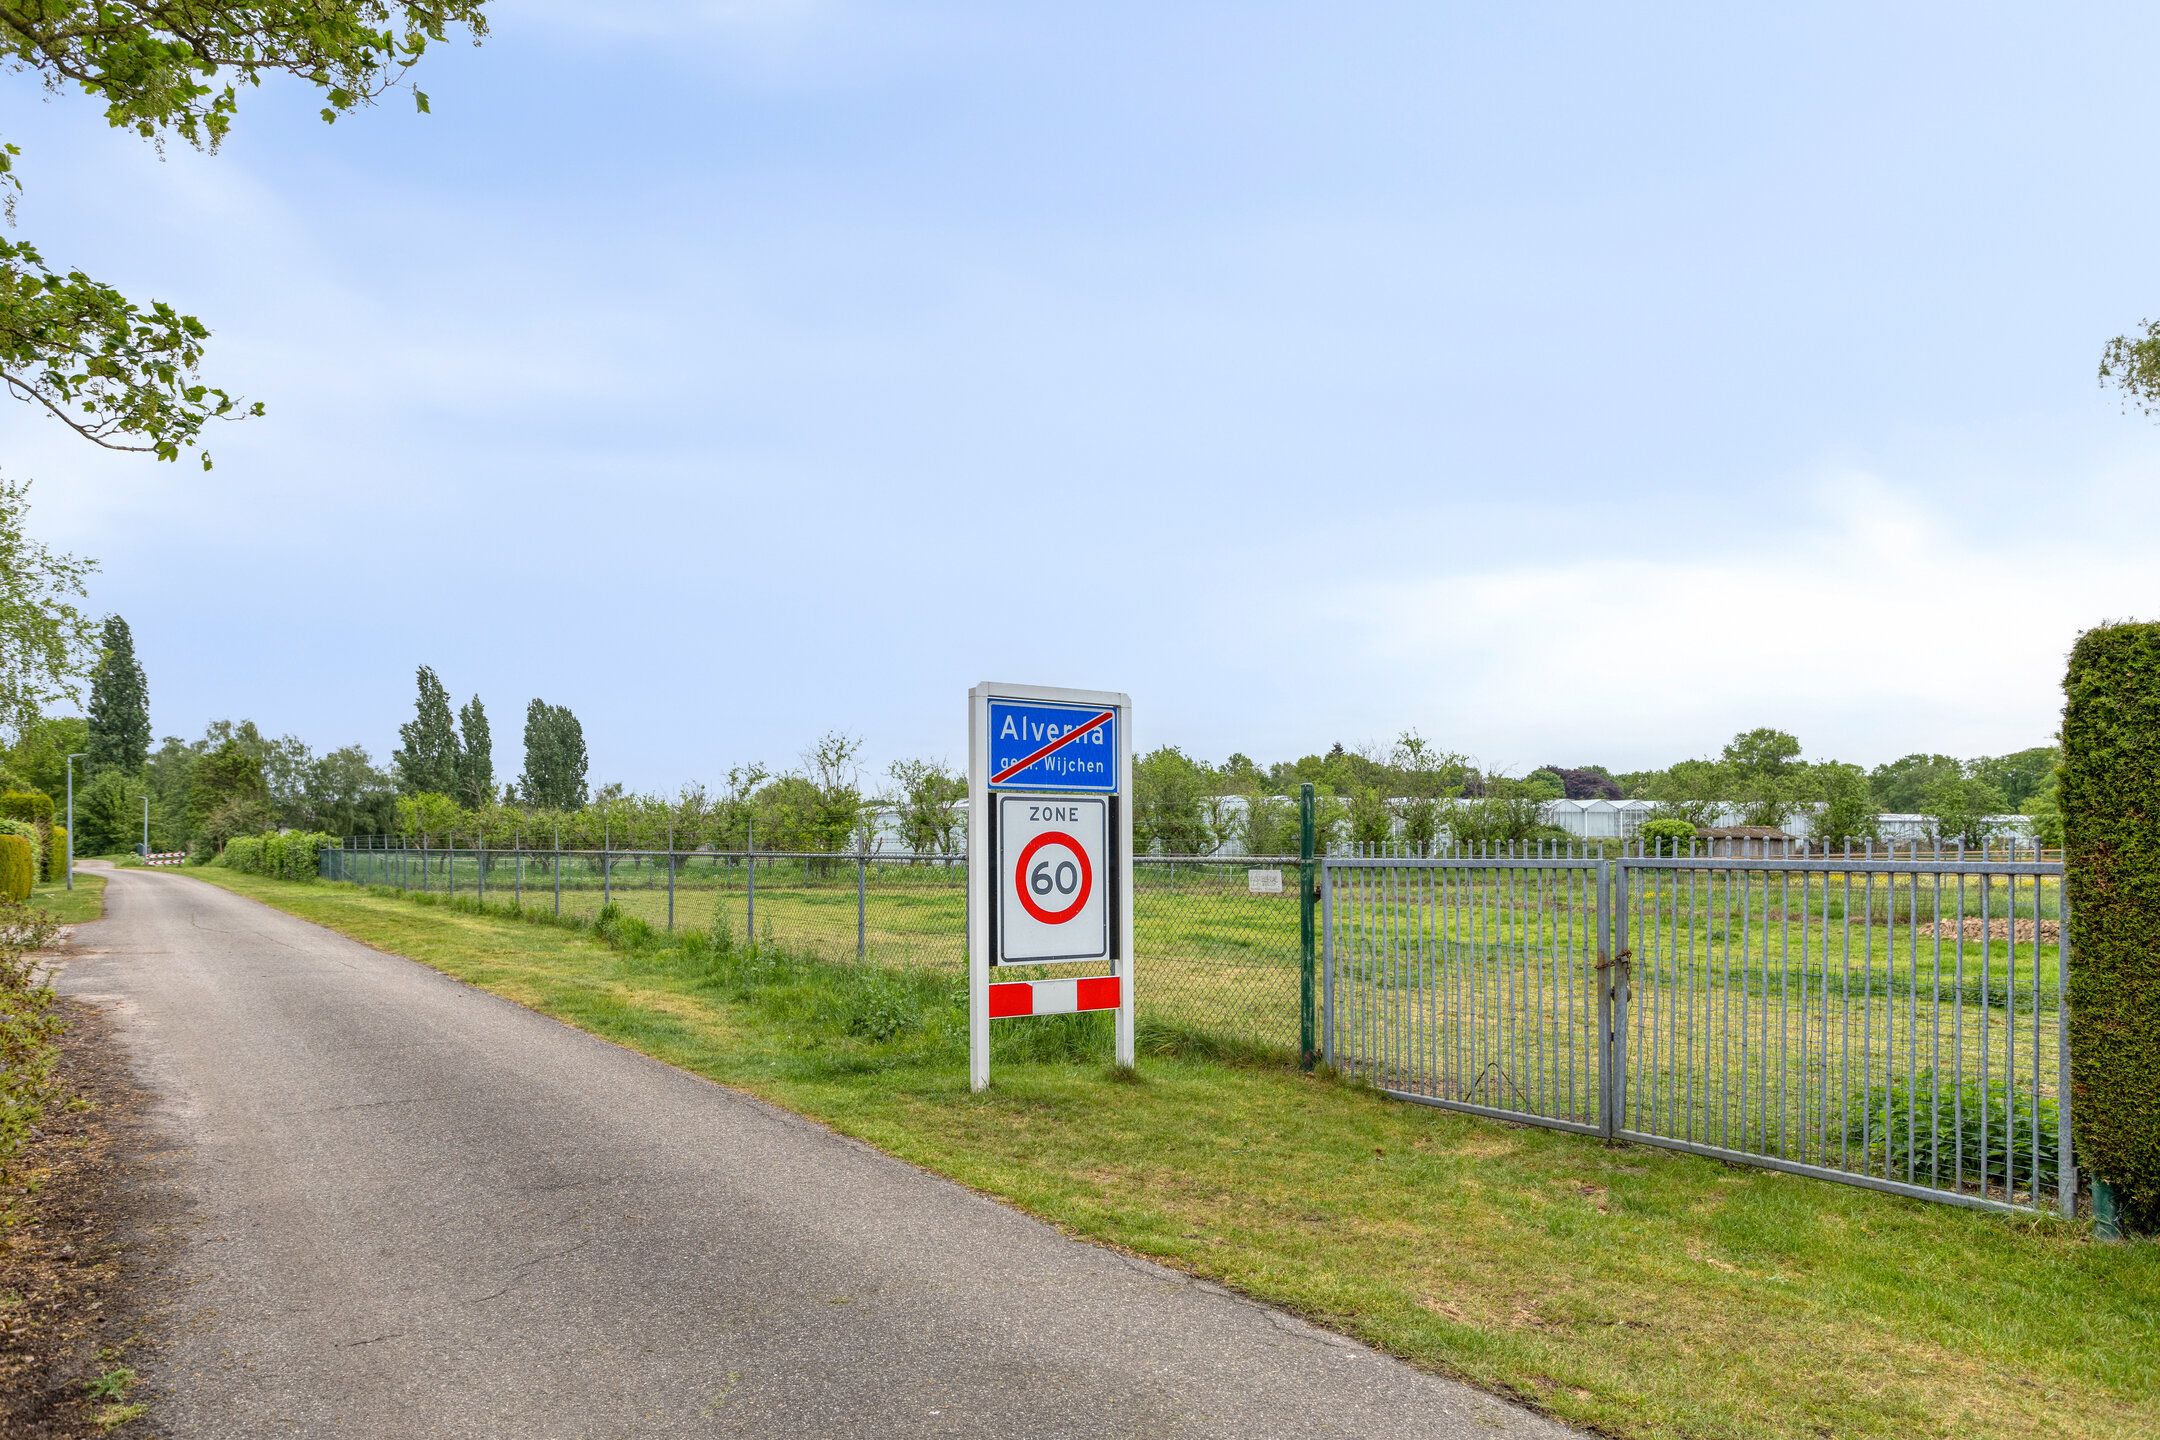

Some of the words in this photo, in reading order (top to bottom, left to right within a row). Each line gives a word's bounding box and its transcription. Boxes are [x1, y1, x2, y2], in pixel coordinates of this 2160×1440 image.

[1000, 757, 1038, 771] ge.
[1044, 756, 1104, 776] Wijchen
[1029, 806, 1079, 822] ZONE
[1030, 860, 1078, 896] 60
